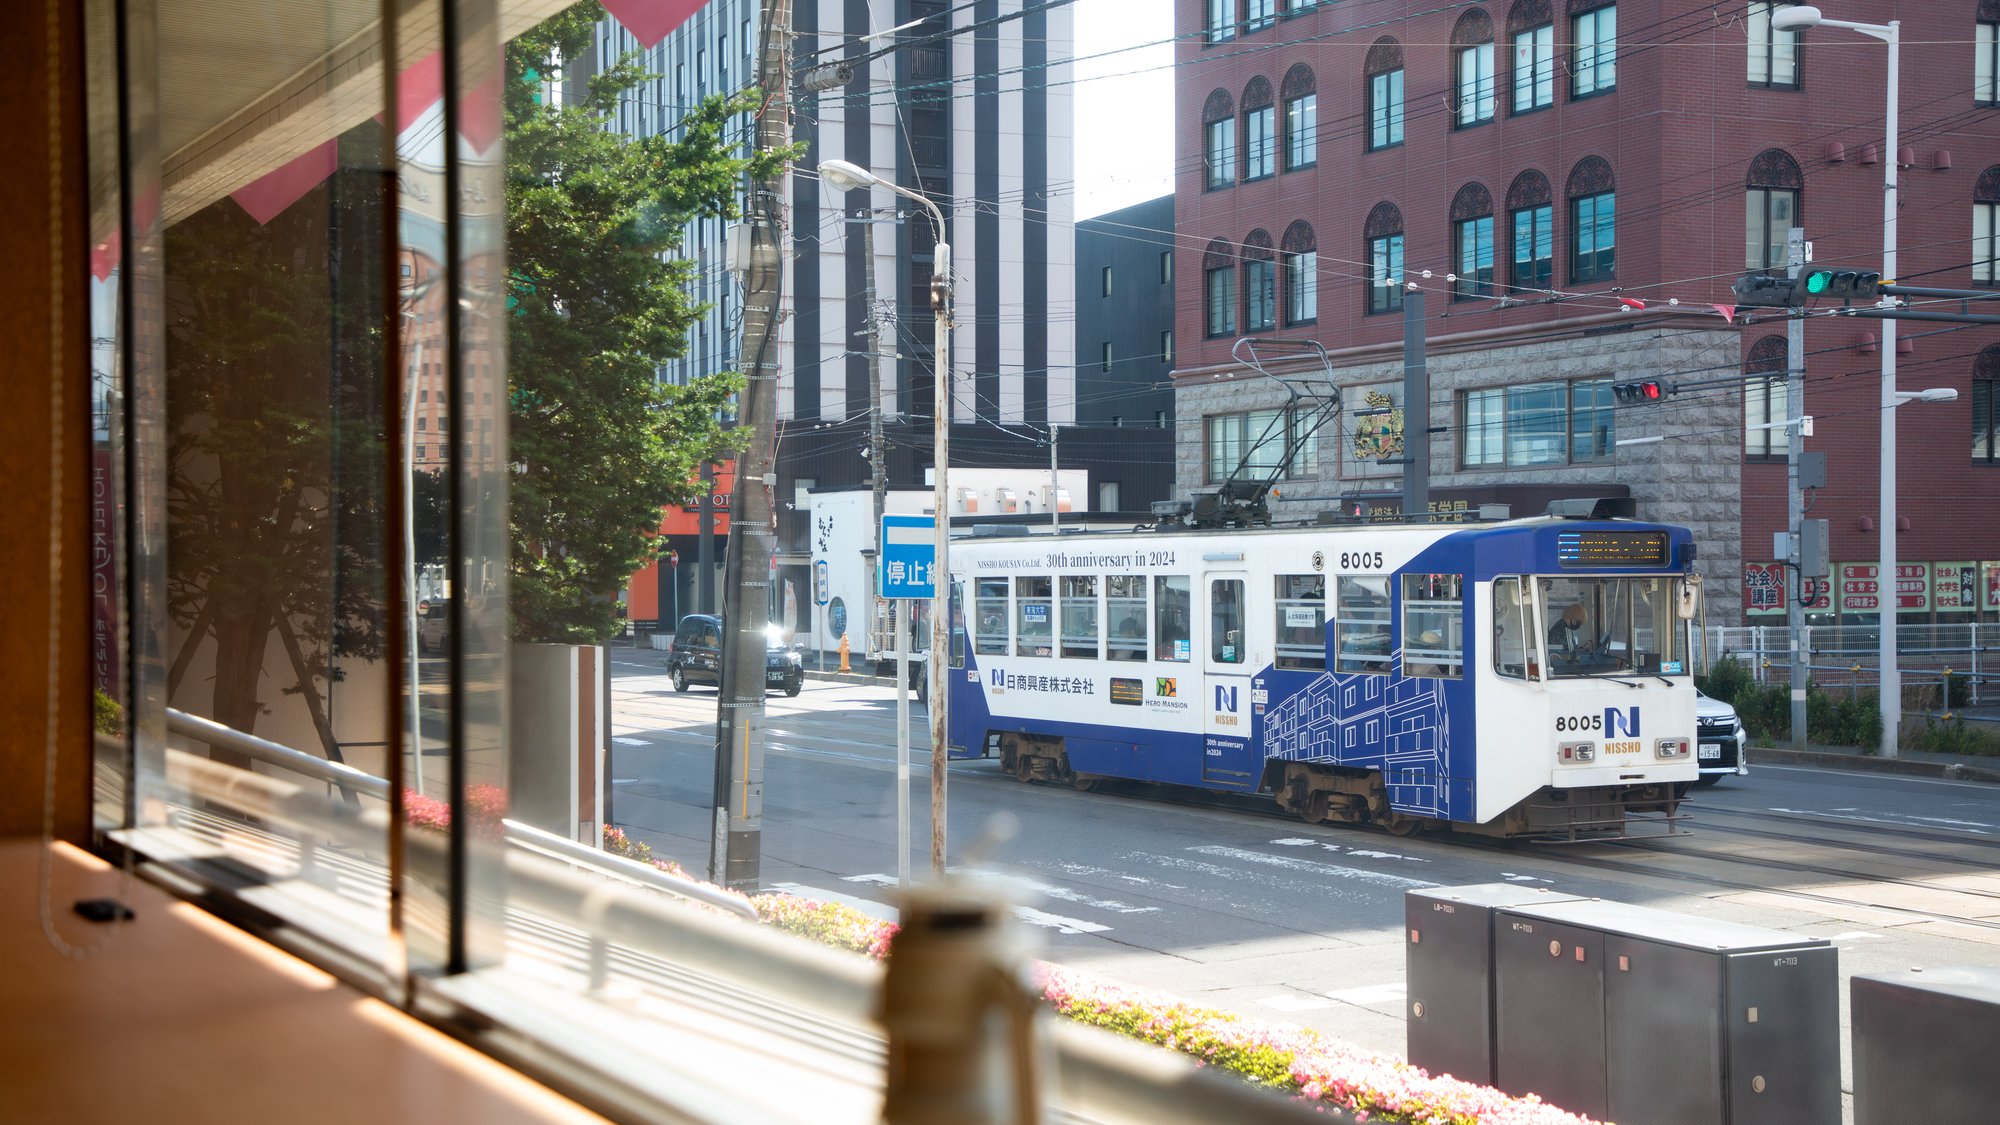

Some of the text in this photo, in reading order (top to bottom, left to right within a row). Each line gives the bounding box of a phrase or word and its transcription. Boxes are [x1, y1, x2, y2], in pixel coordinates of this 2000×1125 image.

[978, 560, 998, 569] NISSHO
[1046, 552, 1068, 568] 30th
[1070, 552, 1132, 571] anniversary
[1135, 551, 1146, 567] in
[1149, 551, 1176, 566] 2024
[1341, 552, 1383, 569] 8005
[1746, 569, 1784, 587] 社会人
[1937, 568, 1959, 577] 社会人
[1962, 571, 1974, 603] 対象
[1752, 588, 1778, 606] 講座
[1007, 675, 1095, 695] 日商興産株式会社
[1145, 699, 1188, 709] HERO MANSION
[1215, 715, 1238, 726] NISSHO
[1556, 715, 1602, 731] 8005
[1206, 738, 1244, 750] 30th anniversary
[1605, 741, 1641, 754] NISSHO
